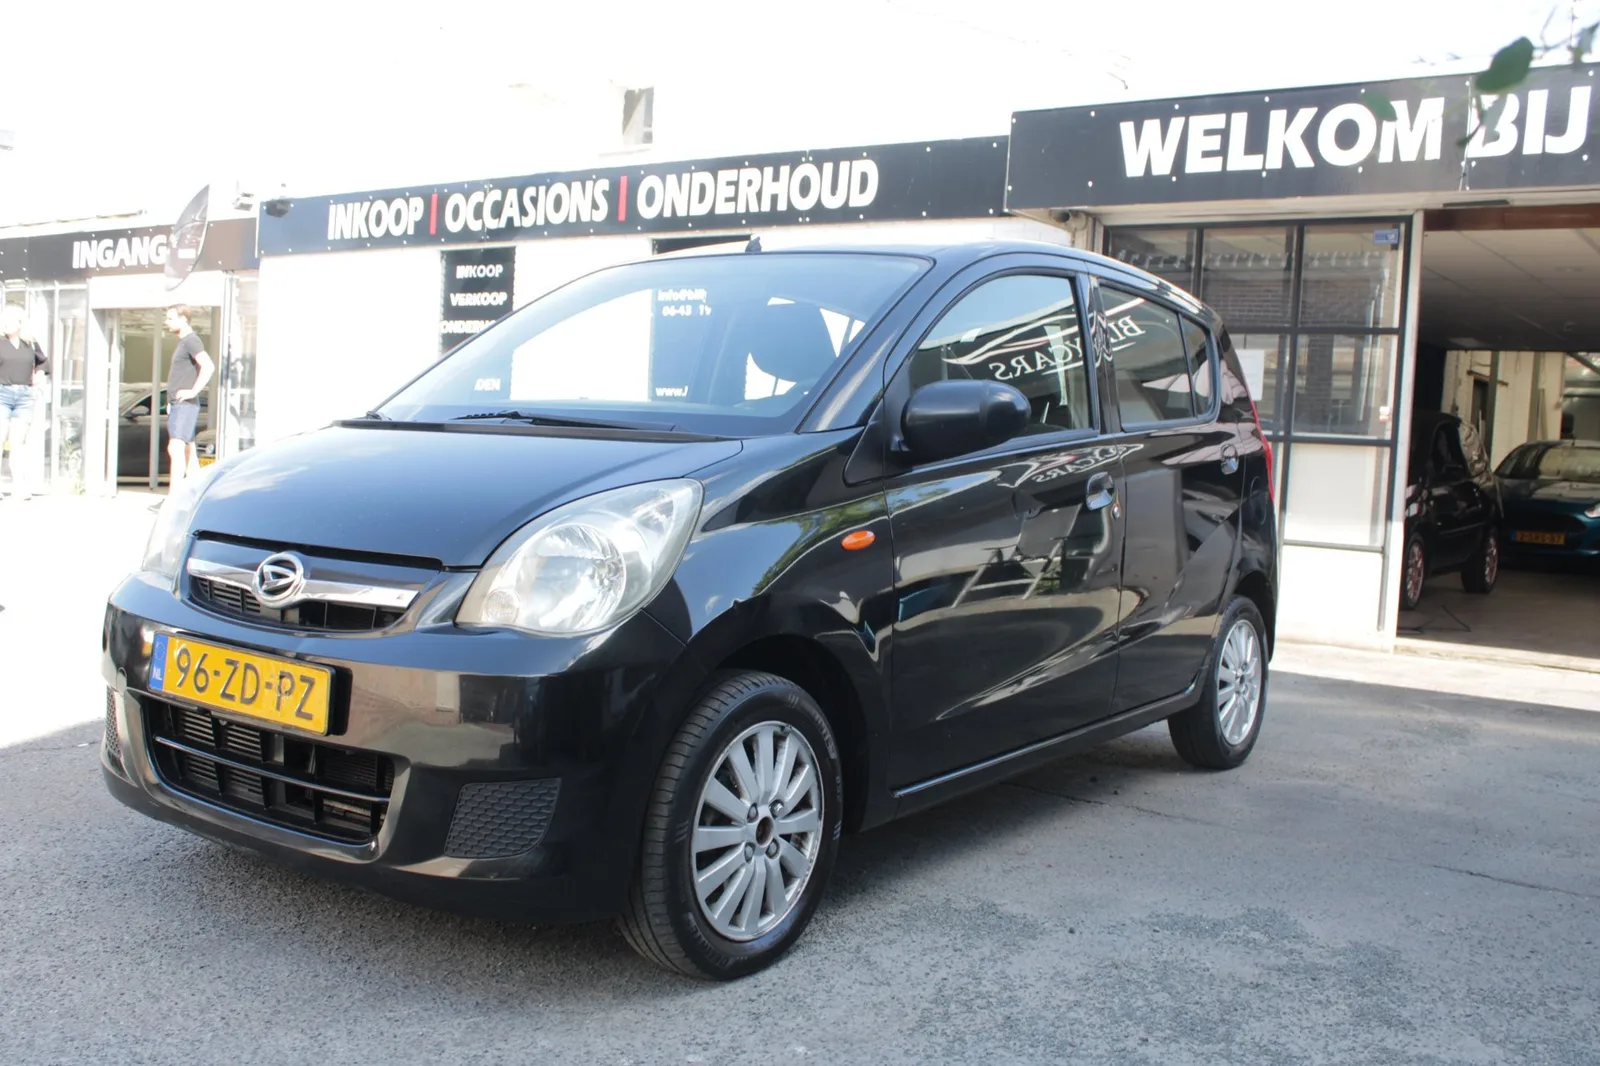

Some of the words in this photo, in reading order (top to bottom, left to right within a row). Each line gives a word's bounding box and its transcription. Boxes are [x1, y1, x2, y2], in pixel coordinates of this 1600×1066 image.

[1119, 97, 1445, 178] WELKOM
[1466, 86, 1592, 159] BIJ
[327, 196, 424, 240] INKOOP
[445, 178, 609, 233] OCCASIONS
[637, 159, 878, 219] ONDERHOUD
[72, 235, 169, 269] INGANG
[455, 264, 504, 279] INKOOP
[449, 291, 508, 306] VERKOOP
[152, 666, 163, 681] NL
[176, 645, 316, 720] 96-ZD-PZ
